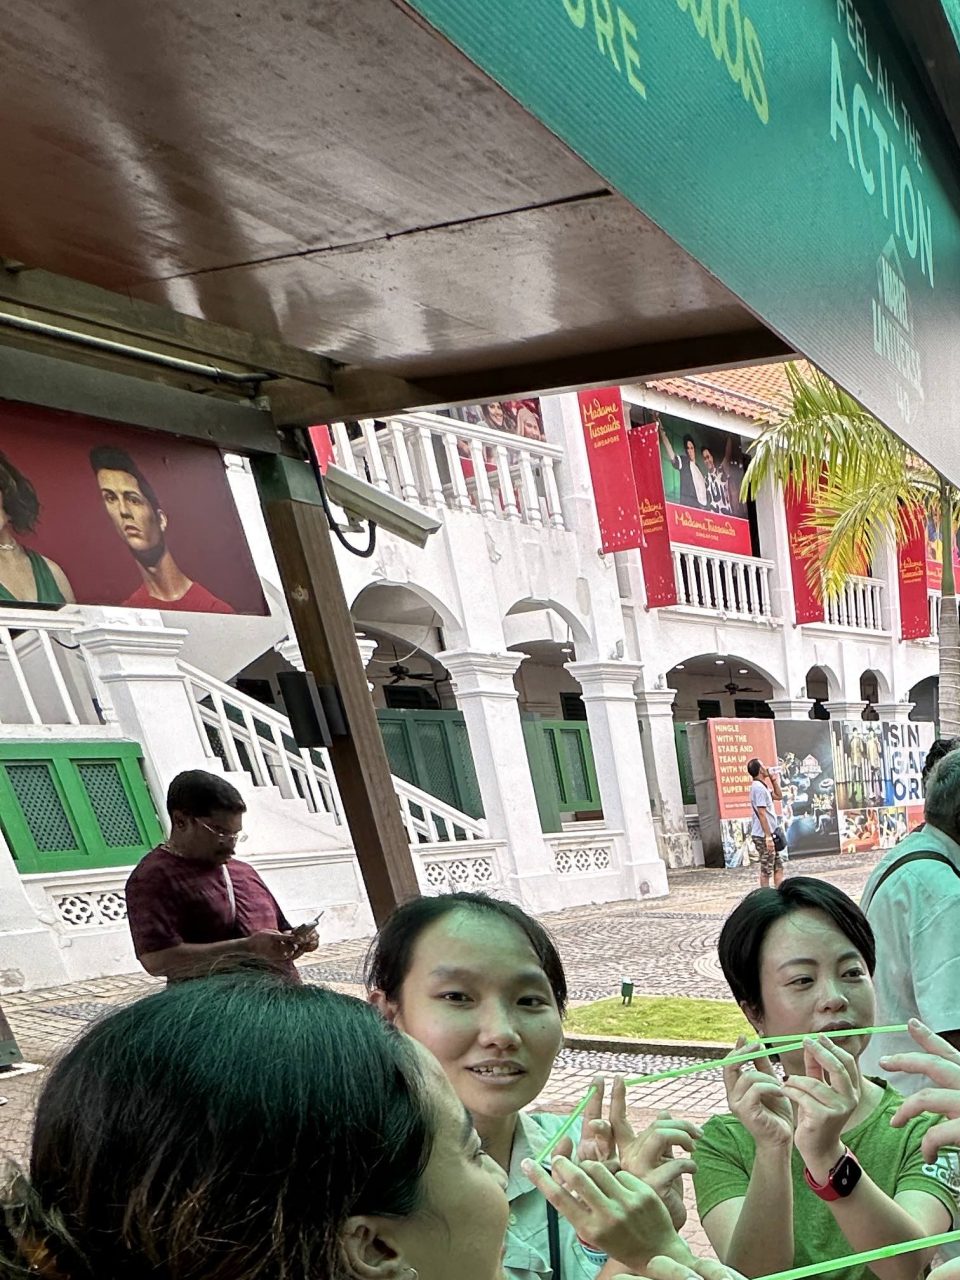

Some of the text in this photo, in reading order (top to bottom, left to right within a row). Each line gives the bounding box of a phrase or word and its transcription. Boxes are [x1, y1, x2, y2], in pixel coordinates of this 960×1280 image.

[837, 0, 922, 174] FEEL ALL THE
[830, 37, 934, 289] ACTION
[582, 398, 619, 422] Madame
[585, 414, 621, 439] Tussauds
[674, 510, 736, 537] Madame Tussauds
[716, 735, 734, 743] WITH
[889, 724, 920, 748] SIN
[723, 786, 743, 794] SUPER
